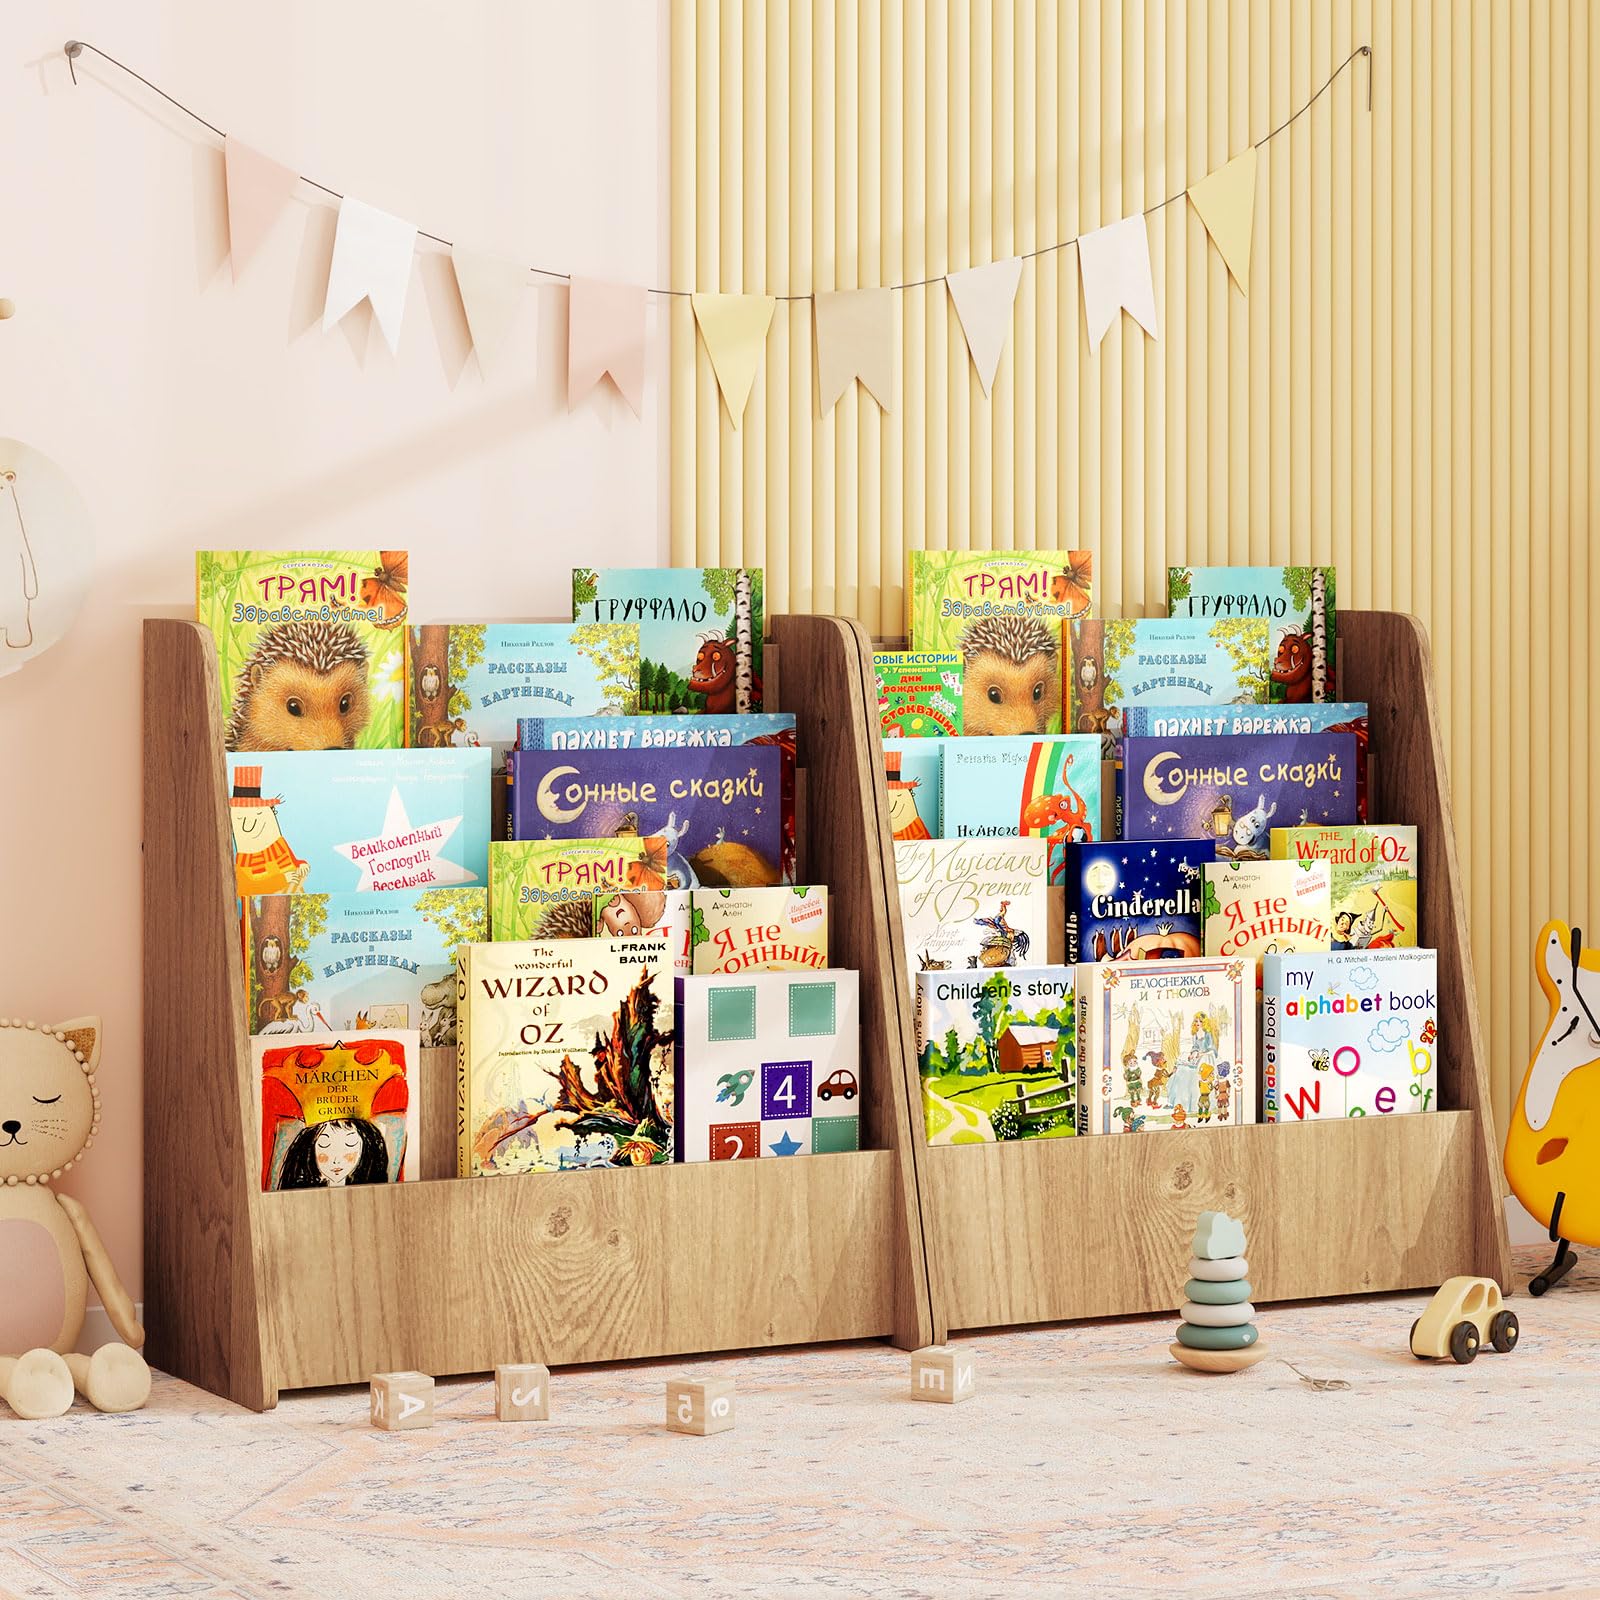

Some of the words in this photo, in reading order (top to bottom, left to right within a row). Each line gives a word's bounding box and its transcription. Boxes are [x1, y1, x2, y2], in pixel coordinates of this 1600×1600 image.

[258, 572, 357, 603] ТРЯМ!
[964, 570, 1048, 599] ТРЯМ!
[233, 603, 383, 624] Здравствуйте!
[593, 597, 707, 623] ГРУФФАЛО
[941, 598, 1071, 619] Здравствуйте!
[1187, 594, 1287, 618] ГРУФФАЛО
[488, 661, 568, 675] РАССКАЗЫ
[906, 654, 958, 664] ИСТОРИИ
[1138, 654, 1207, 665] РАССКАЗЫ
[480, 685, 574, 708] КАРТИНКАХ
[1132, 676, 1214, 697] КАРТИНКАХ
[1259, 760, 1341, 788] сказки
[670, 775, 764, 805] сказки
[1319, 831, 1343, 841] THE
[896, 841, 926, 868] The
[1295, 835, 1357, 864] Wizard
[1359, 835, 1378, 863] of
[1380, 836, 1410, 863] Oz
[541, 857, 624, 885] ТРЯМ!
[897, 840, 1045, 884] Musicians
[1222, 874, 1261, 883] Джонатан
[1232, 882, 1251, 890] Ален
[712, 901, 752, 910] Джонатан
[908, 879, 943, 918] of
[933, 873, 1032, 923] Bremen
[1091, 889, 1201, 918] Cinderella
[1224, 899, 1247, 932] Я
[1253, 897, 1287, 916] не
[330, 929, 412, 944] РАССКАЗЫ
[713, 926, 738, 959] Я
[745, 924, 781, 945] не
[1220, 917, 1329, 957] сонный!
[532, 948, 554, 957] The
[619, 955, 658, 964] BAUM
[1344, 955, 1368, 964] Mitchell
[322, 954, 420, 979] КАРТИНКАХ
[514, 959, 573, 970] wonderful
[937, 982, 1022, 1001] Children's
[1027, 980, 1069, 999] story
[1130, 975, 1205, 990] БЕЛОСНЕЖКА
[1286, 970, 1314, 990] my
[1139, 991, 1149, 1001] И
[1156, 990, 1162, 1000] 7
[1165, 986, 1211, 1000] ГНОМОВ
[532, 1003, 551, 1016] of
[1285, 993, 1382, 1021] alphabet
[1389, 989, 1436, 1011] book
[1265, 997, 1276, 1038] book
[520, 1022, 564, 1045] OZ
[295, 1068, 380, 1085] MÄRCHEN
[316, 1094, 359, 1105] BRÜDER
[327, 1085, 348, 1094] DER
[773, 1074, 797, 1109] 4
[1375, 1086, 1396, 1113] e
[318, 1107, 356, 1116] GRIMM
[724, 1135, 744, 1160] 2
